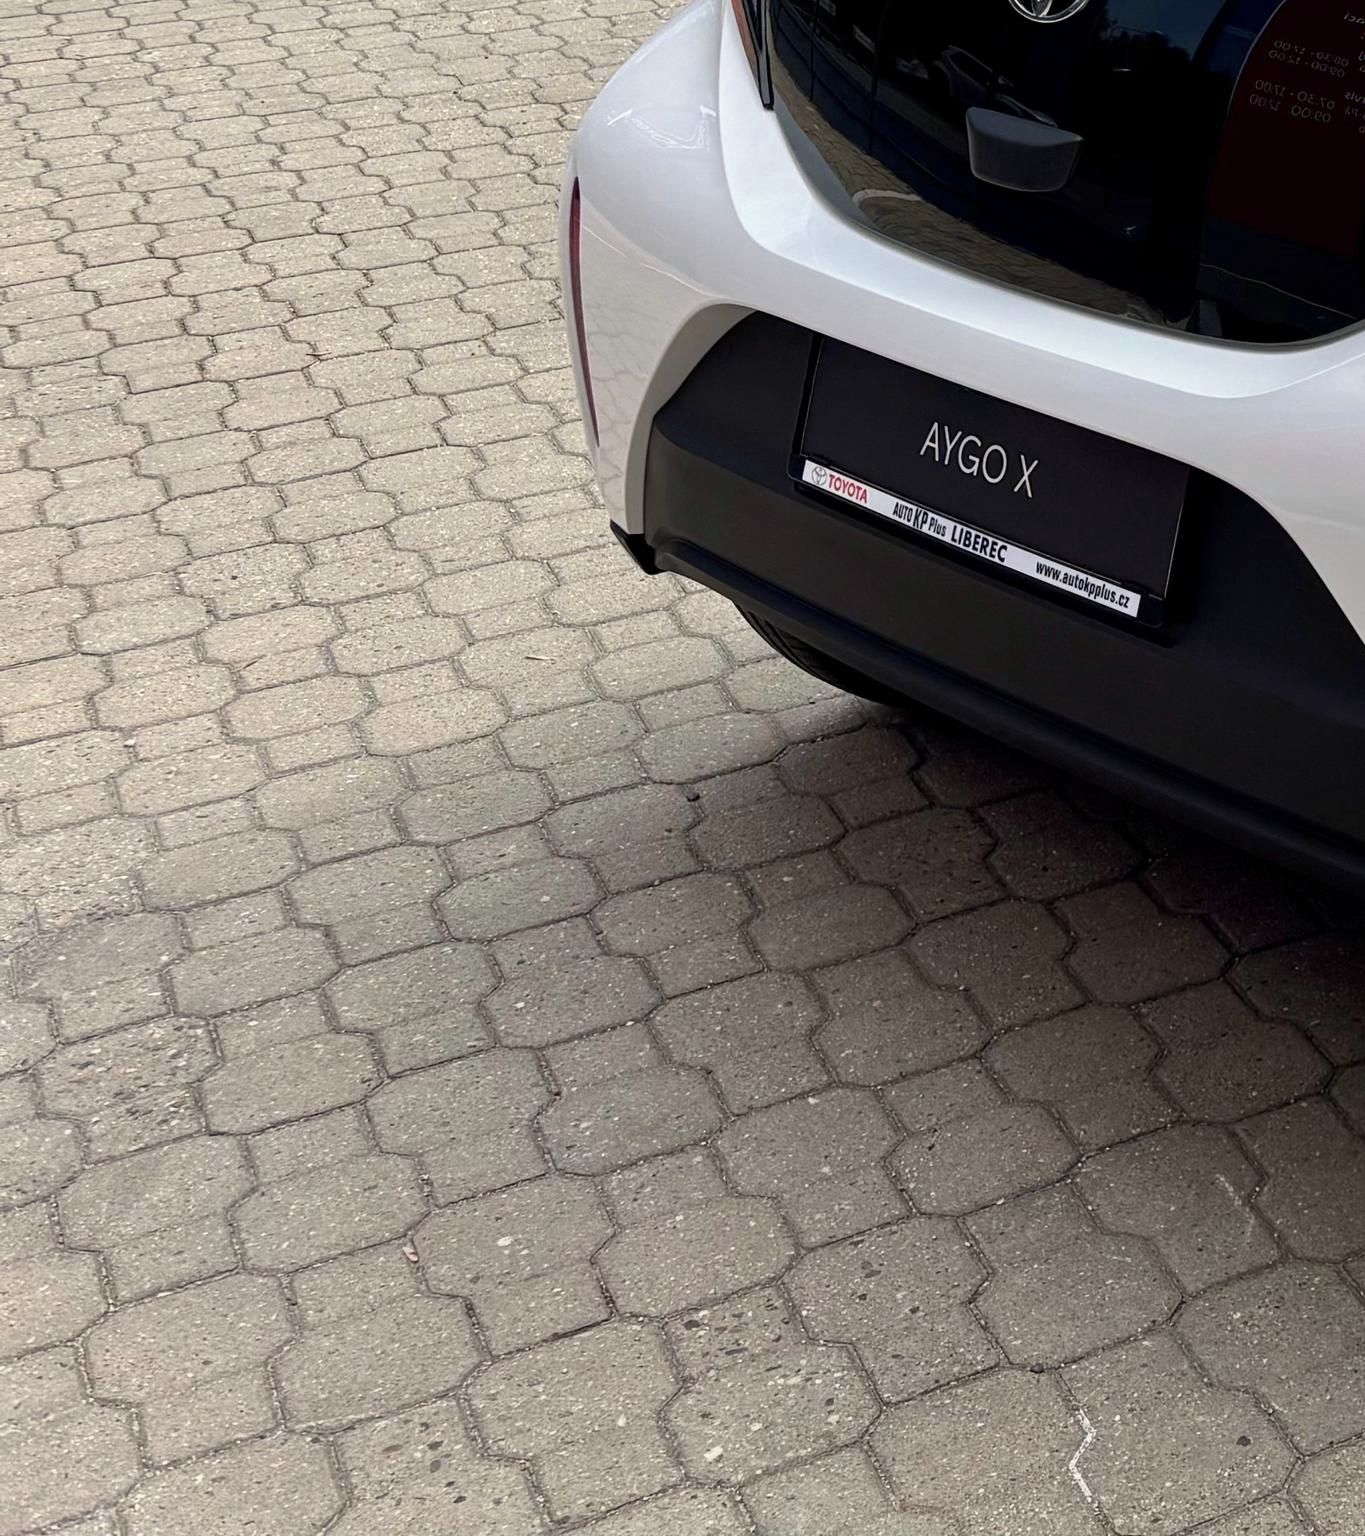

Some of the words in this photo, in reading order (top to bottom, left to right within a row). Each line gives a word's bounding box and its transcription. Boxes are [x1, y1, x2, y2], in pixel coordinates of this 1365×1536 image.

[920, 421, 1008, 484] AYGO
[1013, 454, 1039, 498] X
[828, 473, 869, 505] TOYOTA
[892, 501, 913, 524] AUTO
[912, 508, 928, 531] KP
[928, 517, 947, 537] Plus
[950, 523, 1008, 563] LIBEREC
[1035, 560, 1131, 609] www.autokpplus.cz
